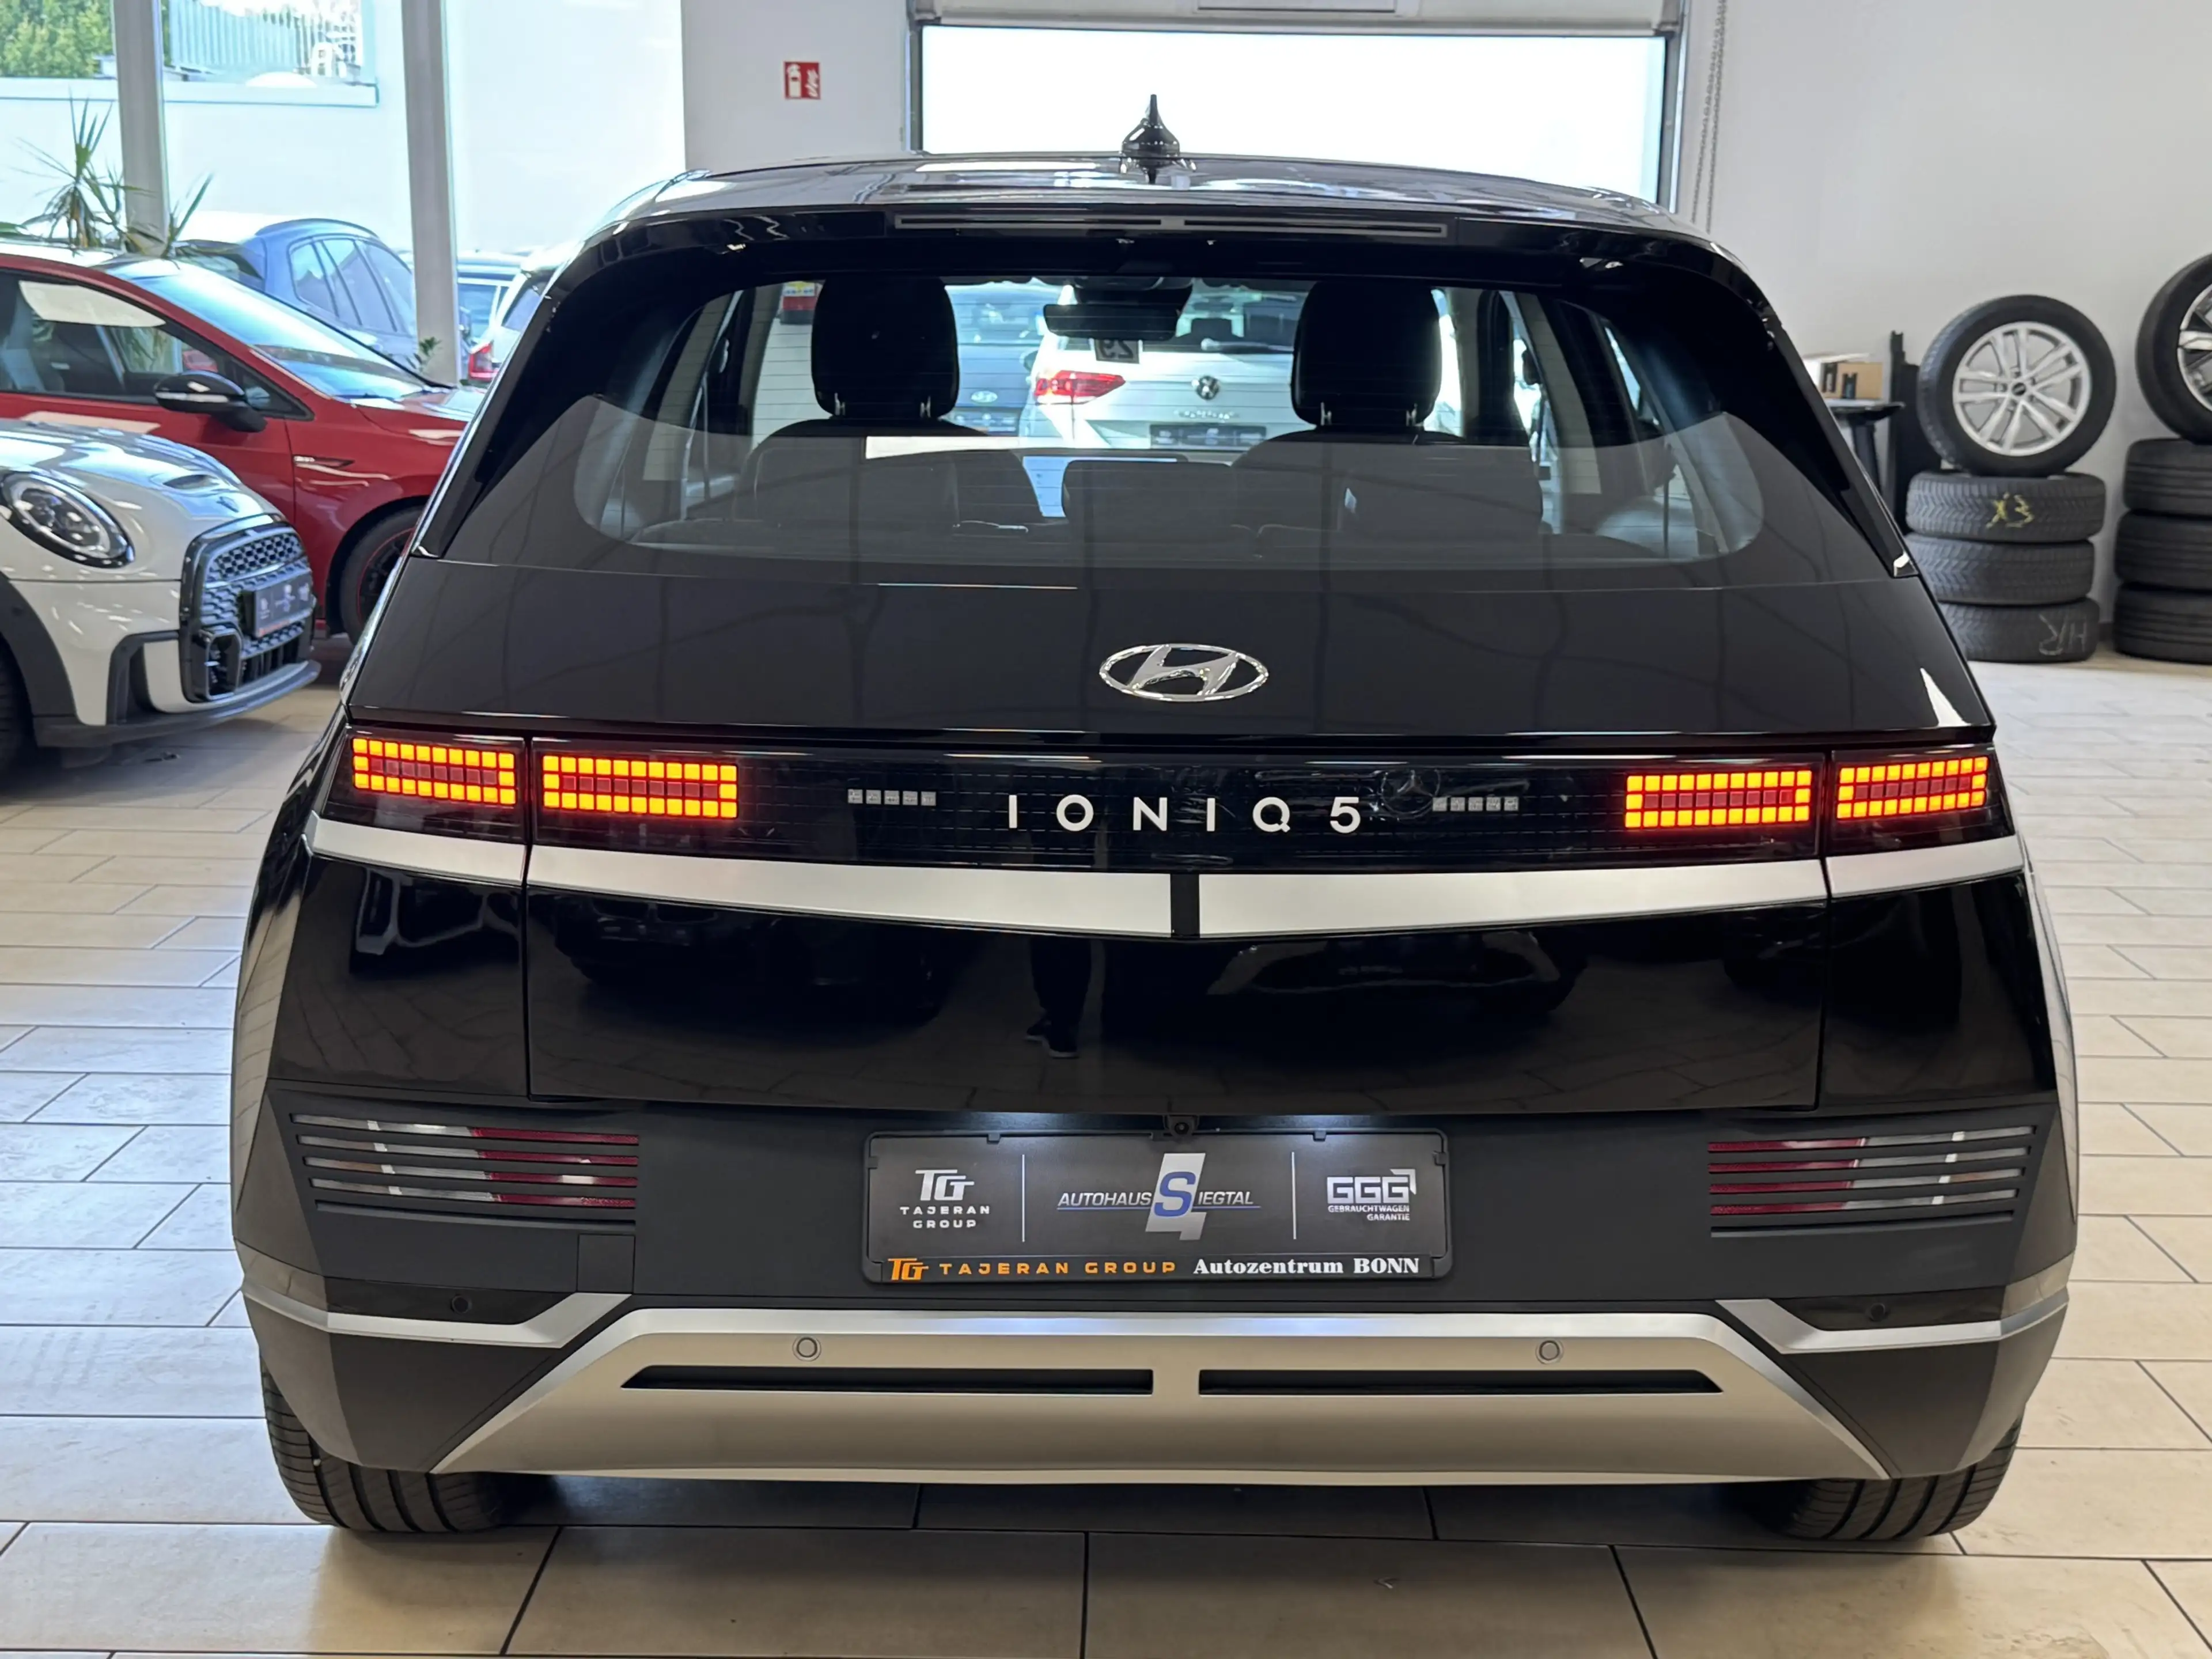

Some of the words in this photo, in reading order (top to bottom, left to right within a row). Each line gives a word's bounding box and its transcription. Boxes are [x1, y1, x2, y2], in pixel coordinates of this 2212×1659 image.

[1986, 492, 2035, 528] X3
[1008, 794, 1291, 833] IONIQ
[1330, 796, 1361, 834] 5
[1326, 1176, 1410, 1204] GGG
[1058, 1191, 1152, 1207] AUTOHAUS
[899, 1205, 990, 1215] TAJERAN
[1327, 1205, 1410, 1213] GEBRAUCHTWAGEN
[1366, 1213, 1411, 1221] GARANTIE
[912, 1219, 977, 1229] GROUP
[939, 1262, 1069, 1275] TAJERAN
[1084, 1261, 1176, 1274] GROUP
[1193, 1258, 1343, 1274] Autozentrum
[1353, 1257, 1420, 1274] BONN
